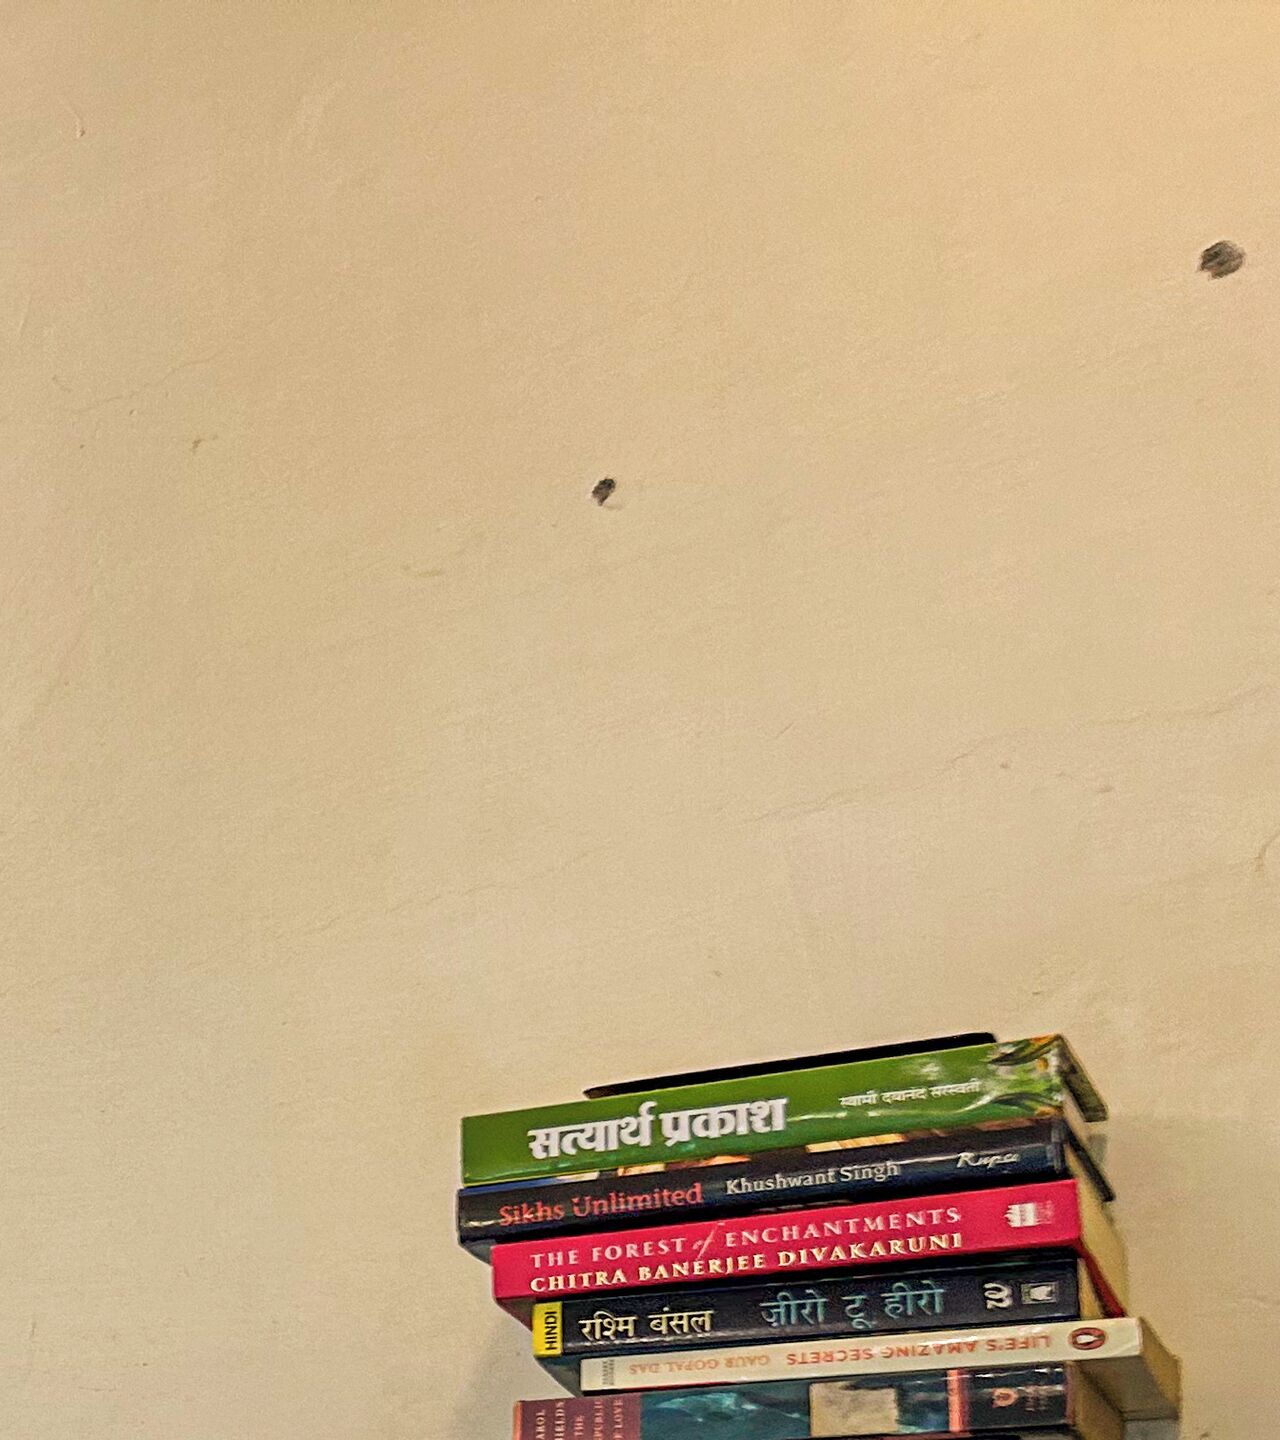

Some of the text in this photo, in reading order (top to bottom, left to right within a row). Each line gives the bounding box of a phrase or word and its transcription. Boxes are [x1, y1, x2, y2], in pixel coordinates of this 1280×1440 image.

[527, 1098, 788, 1160] सत्यार्थ प्रकाश
[726, 1161, 901, 1195] Khushwant Singh
[499, 1183, 703, 1226] Sikhs Unlimited
[531, 1207, 961, 1268] THE FOREST of ENCHANTMENTS
[530, 1232, 963, 1292] CHITRA BANERJEE DIVAKARUNI
[578, 1306, 715, 1341] रश्मि बंसल
[842, 1295, 873, 1329] टू
[880, 1280, 945, 1318] हीरो
[544, 1310, 558, 1351] HINDI
[666, 1360, 719, 1372] GOPAL
[724, 1355, 771, 1368] GAUR
[787, 1335, 1051, 1366] LIFE'S AMAZING SECRETS
[574, 1415, 584, 1436] THE
